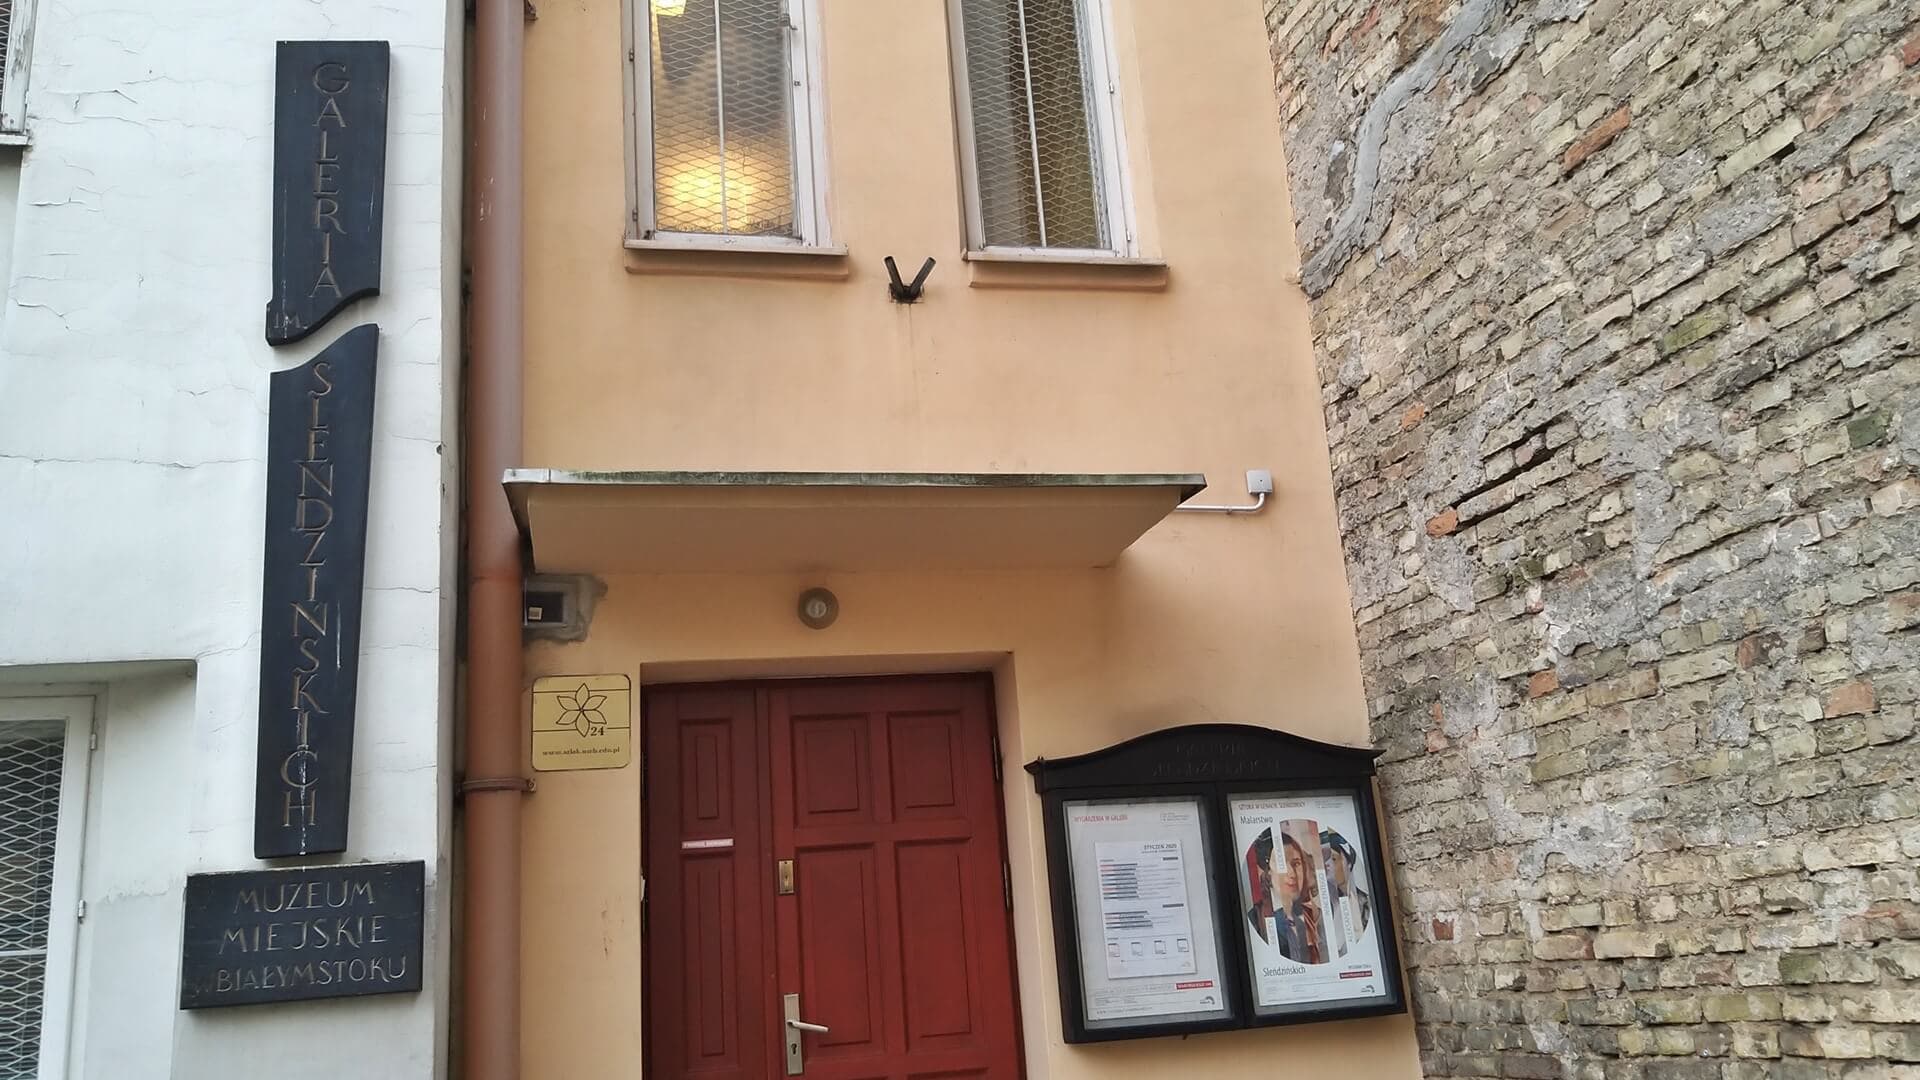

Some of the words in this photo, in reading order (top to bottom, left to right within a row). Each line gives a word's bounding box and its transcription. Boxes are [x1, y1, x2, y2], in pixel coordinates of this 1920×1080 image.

[310, 61, 351, 300] GALERIA
[590, 725, 605, 737] 24
[1240, 815, 1274, 825] Malarstwo
[233, 878, 376, 914] MUZEUM
[218, 914, 388, 955] MIEJSKIE
[216, 954, 407, 992] BIAŁYMSTOKU
